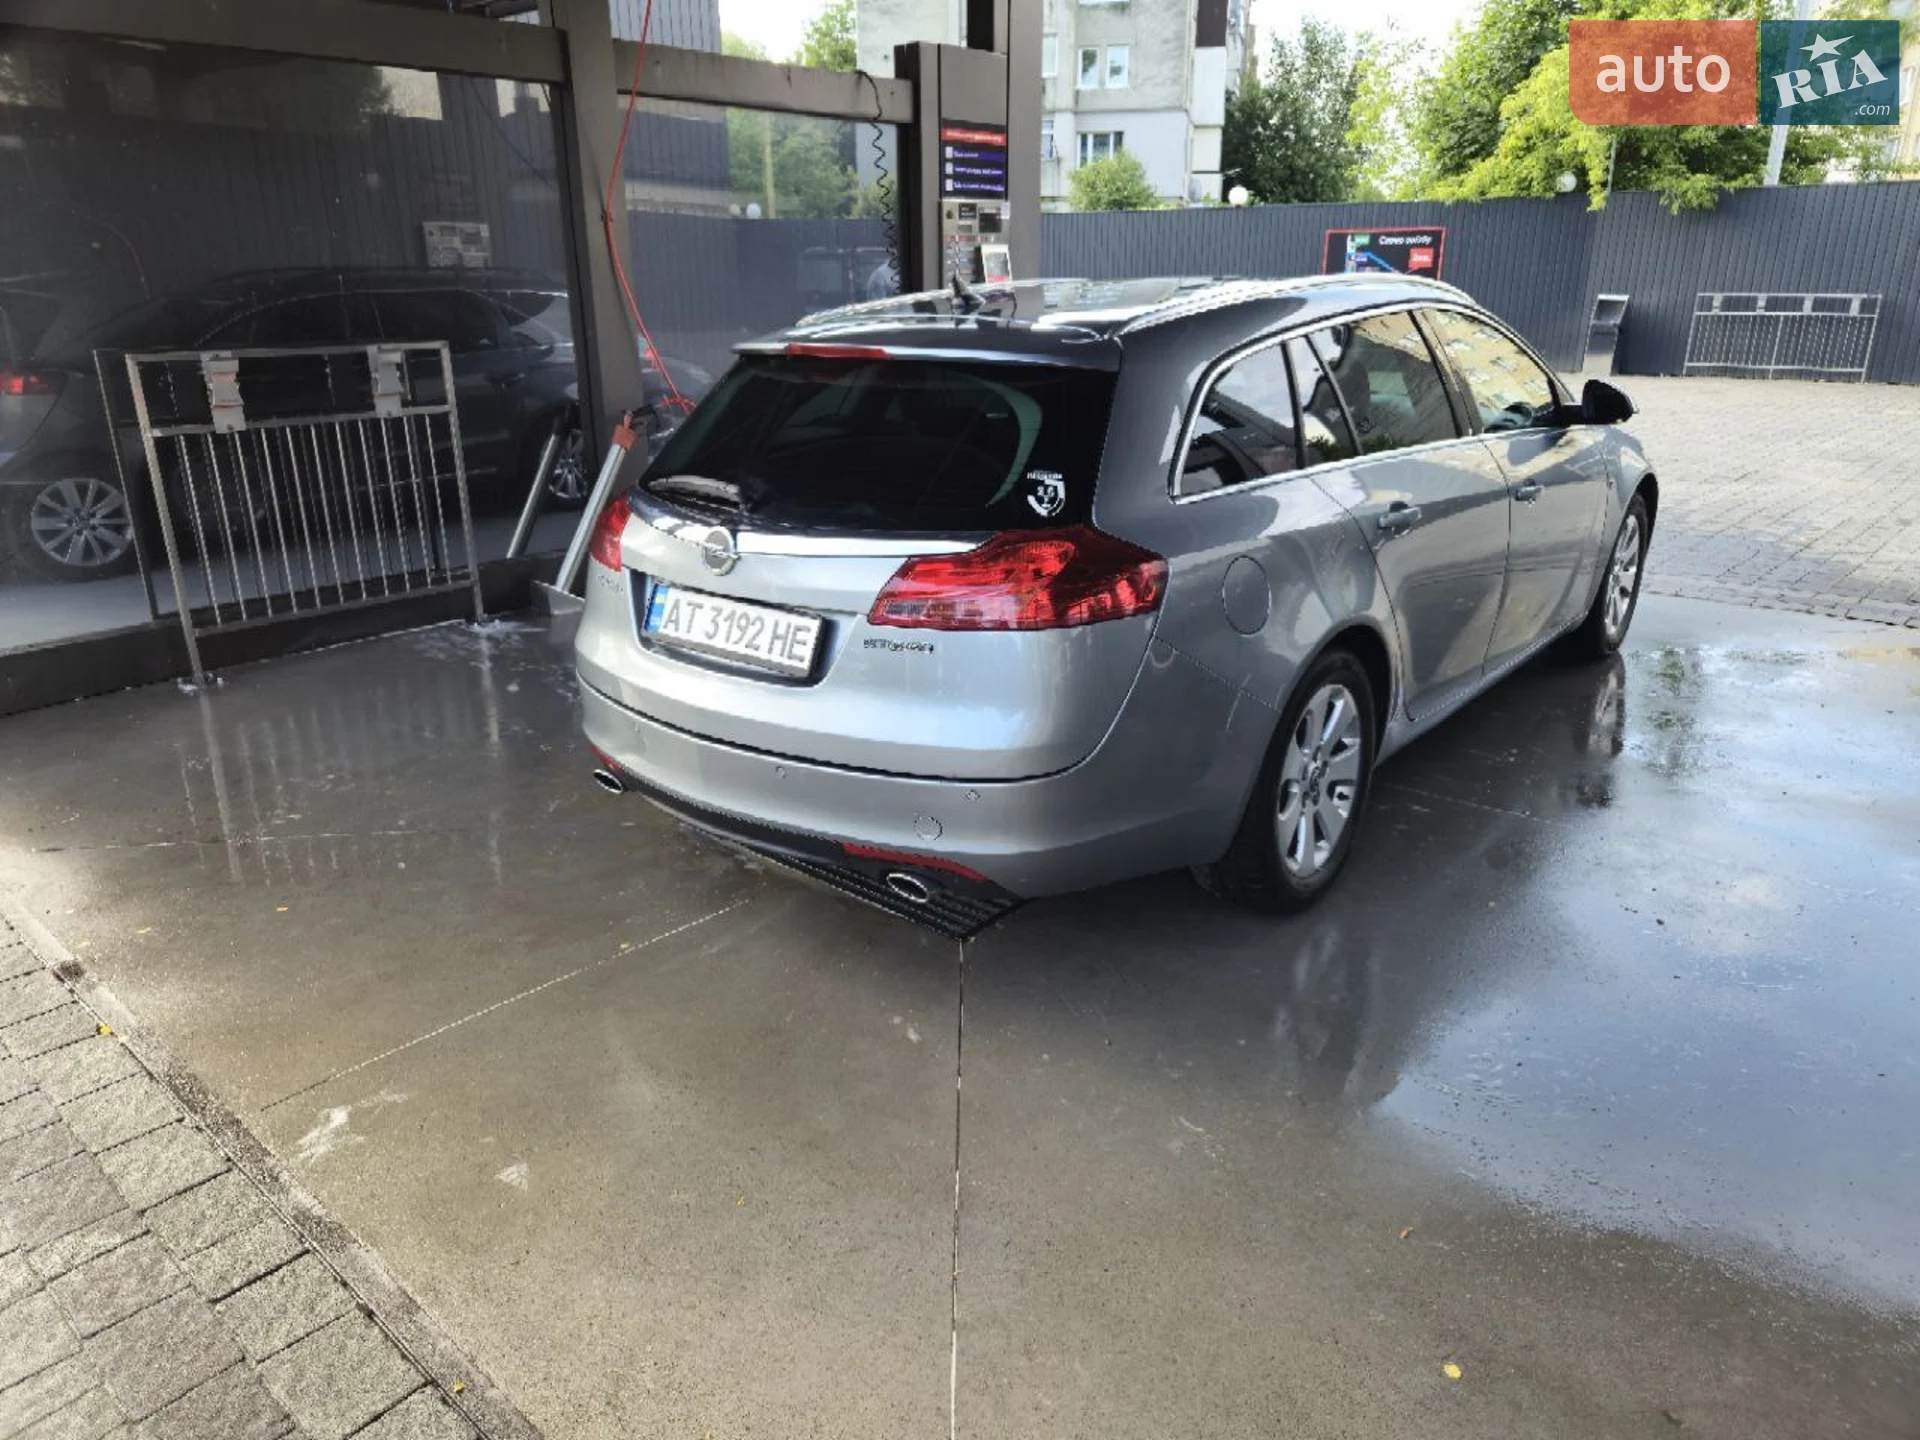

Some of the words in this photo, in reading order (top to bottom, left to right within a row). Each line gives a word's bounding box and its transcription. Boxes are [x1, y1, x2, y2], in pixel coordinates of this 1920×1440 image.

[663, 598, 704, 634] AT
[704, 606, 765, 651] 3192
[767, 620, 811, 662] HE
